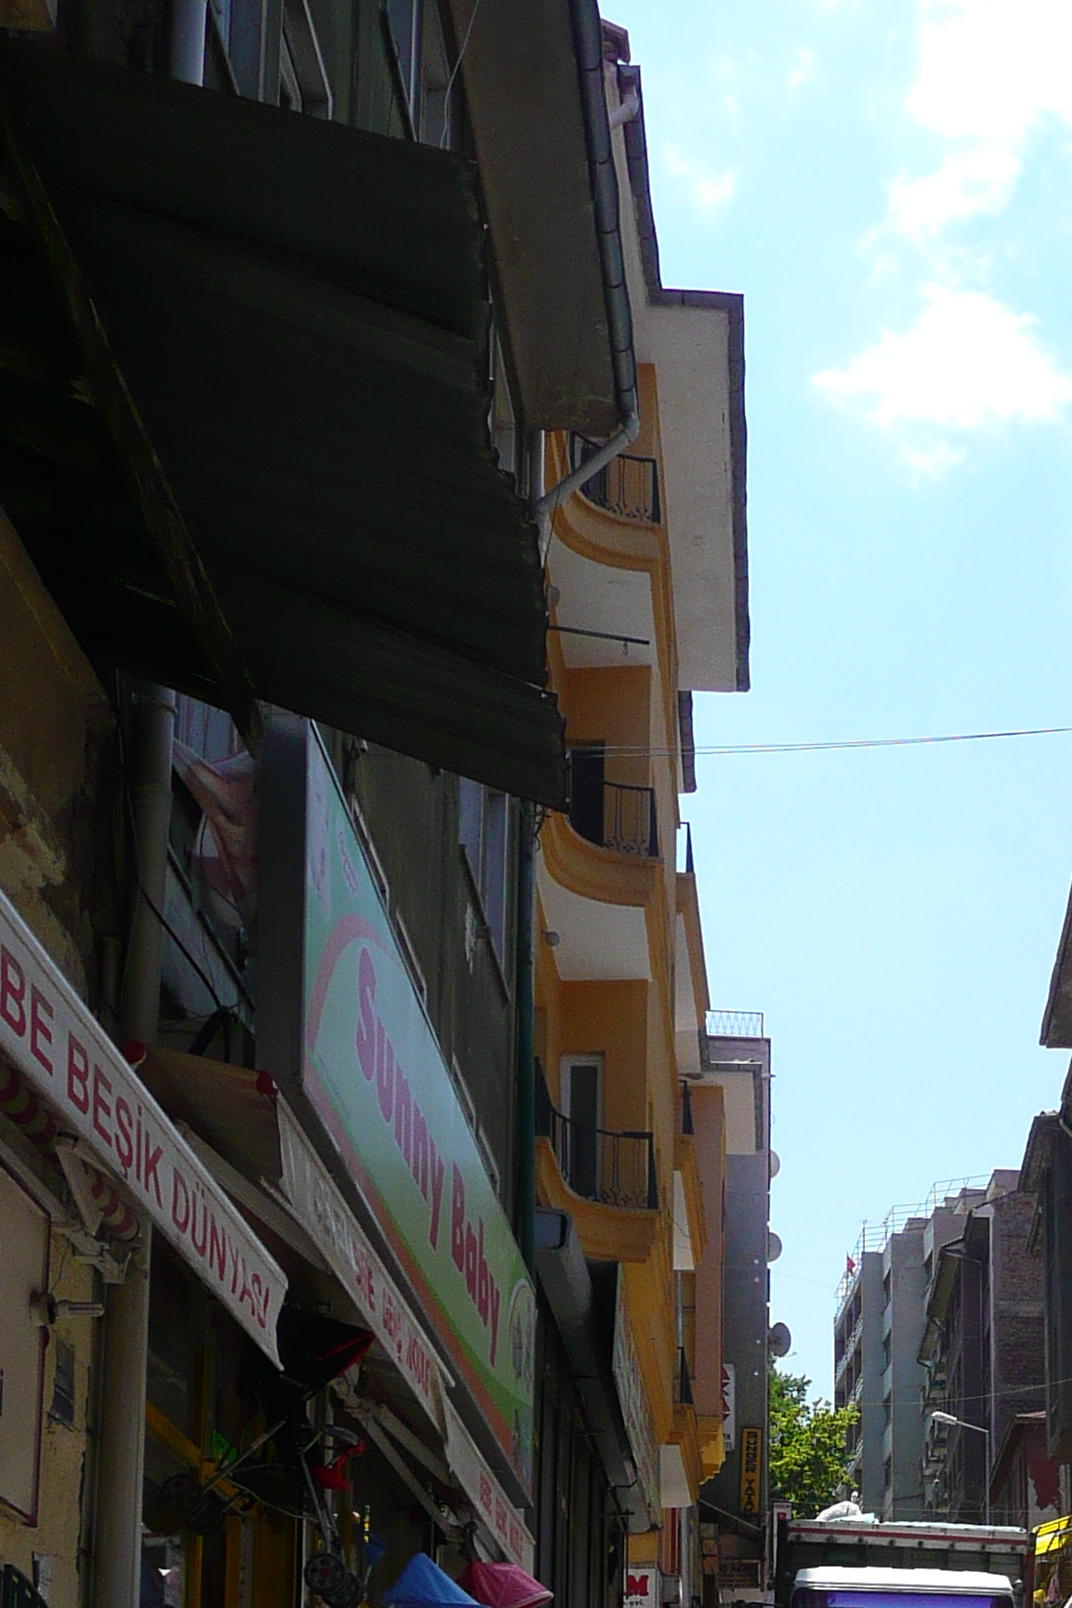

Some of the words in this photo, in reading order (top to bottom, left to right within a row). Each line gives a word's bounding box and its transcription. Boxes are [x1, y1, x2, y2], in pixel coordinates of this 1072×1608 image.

[67, 1031, 164, 1210] BEŞİK
[172, 1166, 271, 1329] DÜNYASI
[355, 946, 445, 1253] Sunny
[449, 1158, 501, 1368] Baby
